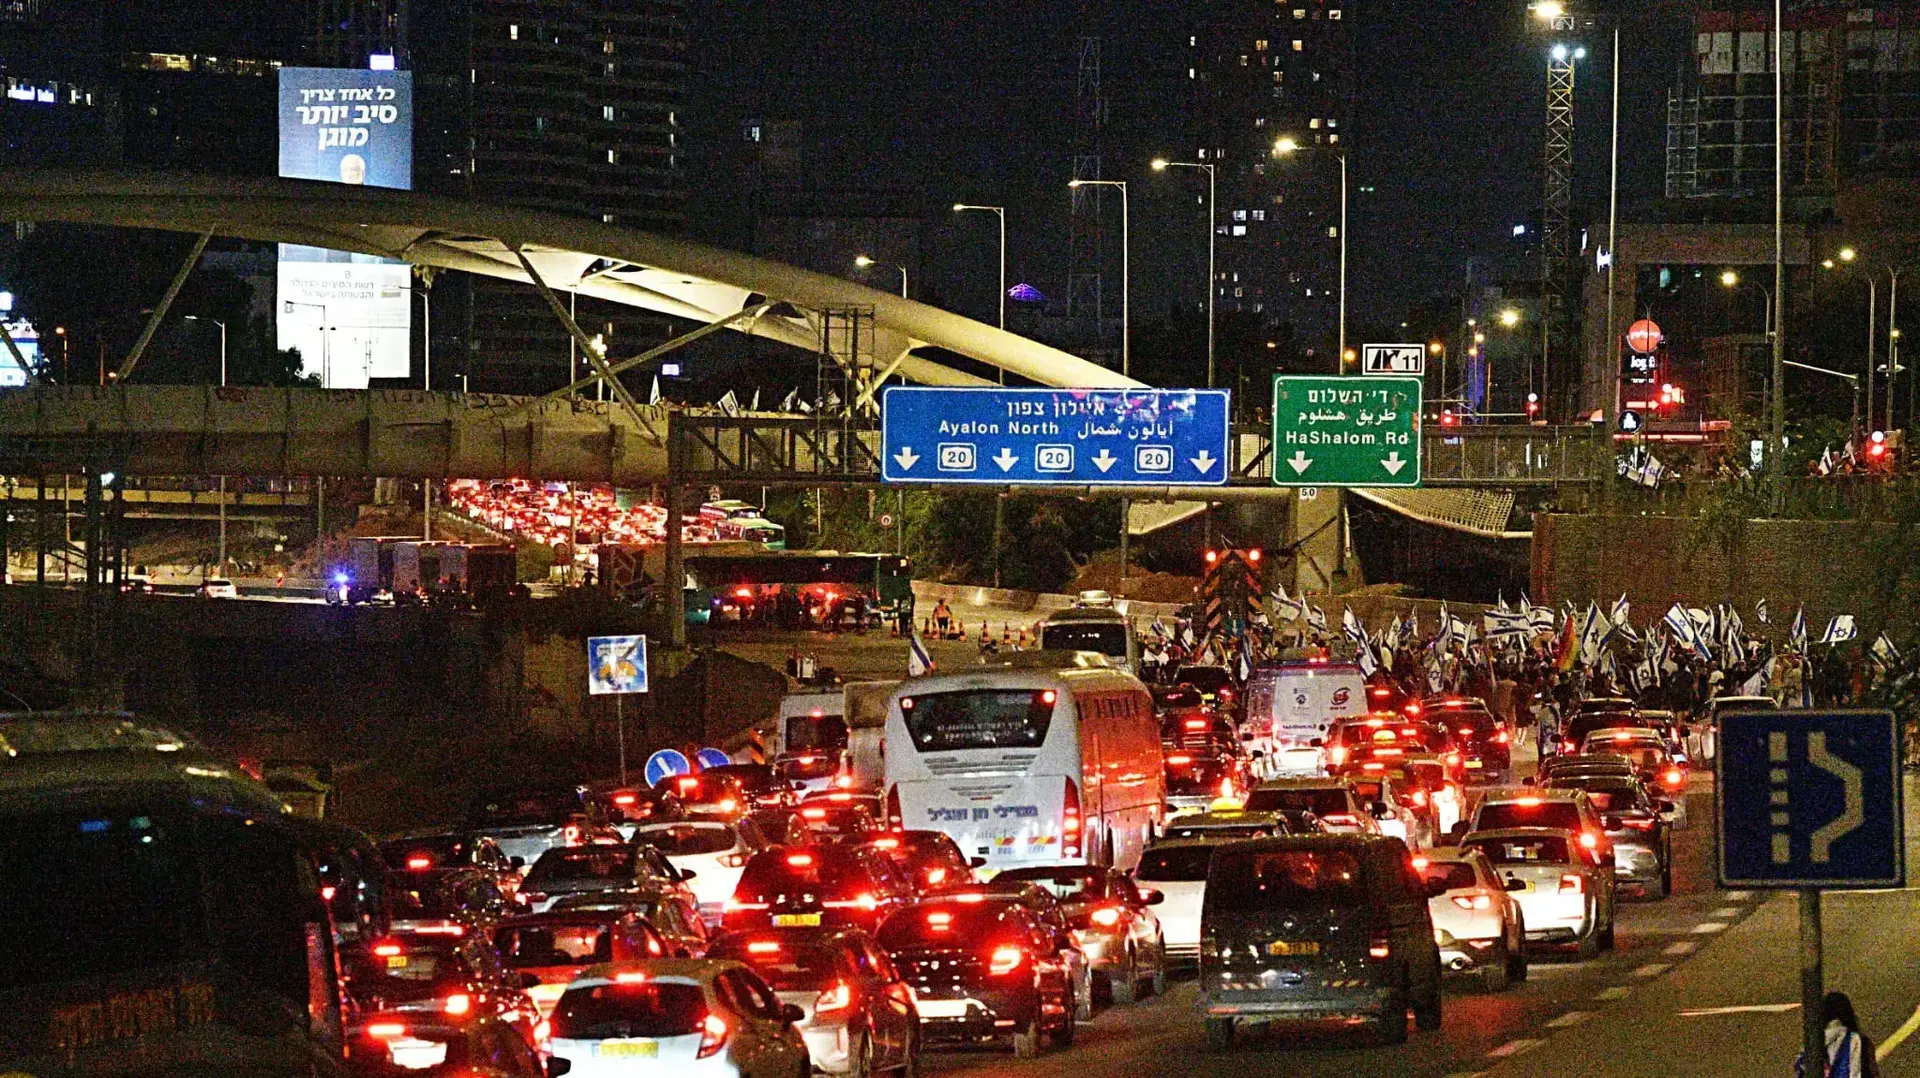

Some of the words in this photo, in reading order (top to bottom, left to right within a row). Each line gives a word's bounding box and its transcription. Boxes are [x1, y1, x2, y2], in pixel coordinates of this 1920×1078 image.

[300, 89, 335, 104] צריך
[339, 89, 373, 101] אחד
[377, 86, 395, 101] כל
[296, 105, 349, 125] יותר
[353, 105, 398, 124] סיב
[318, 127, 369, 151] מוגן
[1403, 355, 1419, 370] 11
[1308, 387, 1363, 404] השלום
[1007, 402, 1045, 417] צפון
[1053, 399, 1105, 417] איילון
[1298, 408, 1347, 425] هشلوم
[1356, 408, 1397, 426] طريق
[939, 420, 999, 437] Ayalon
[1008, 420, 1059, 435] North
[1077, 421, 1121, 440] شمال
[1286, 430, 1375, 445] HaShalom
[1385, 431, 1409, 445] Rd
[947, 451, 967, 463] 20
[1045, 452, 1065, 464] 20
[1144, 453, 1164, 465] 20
